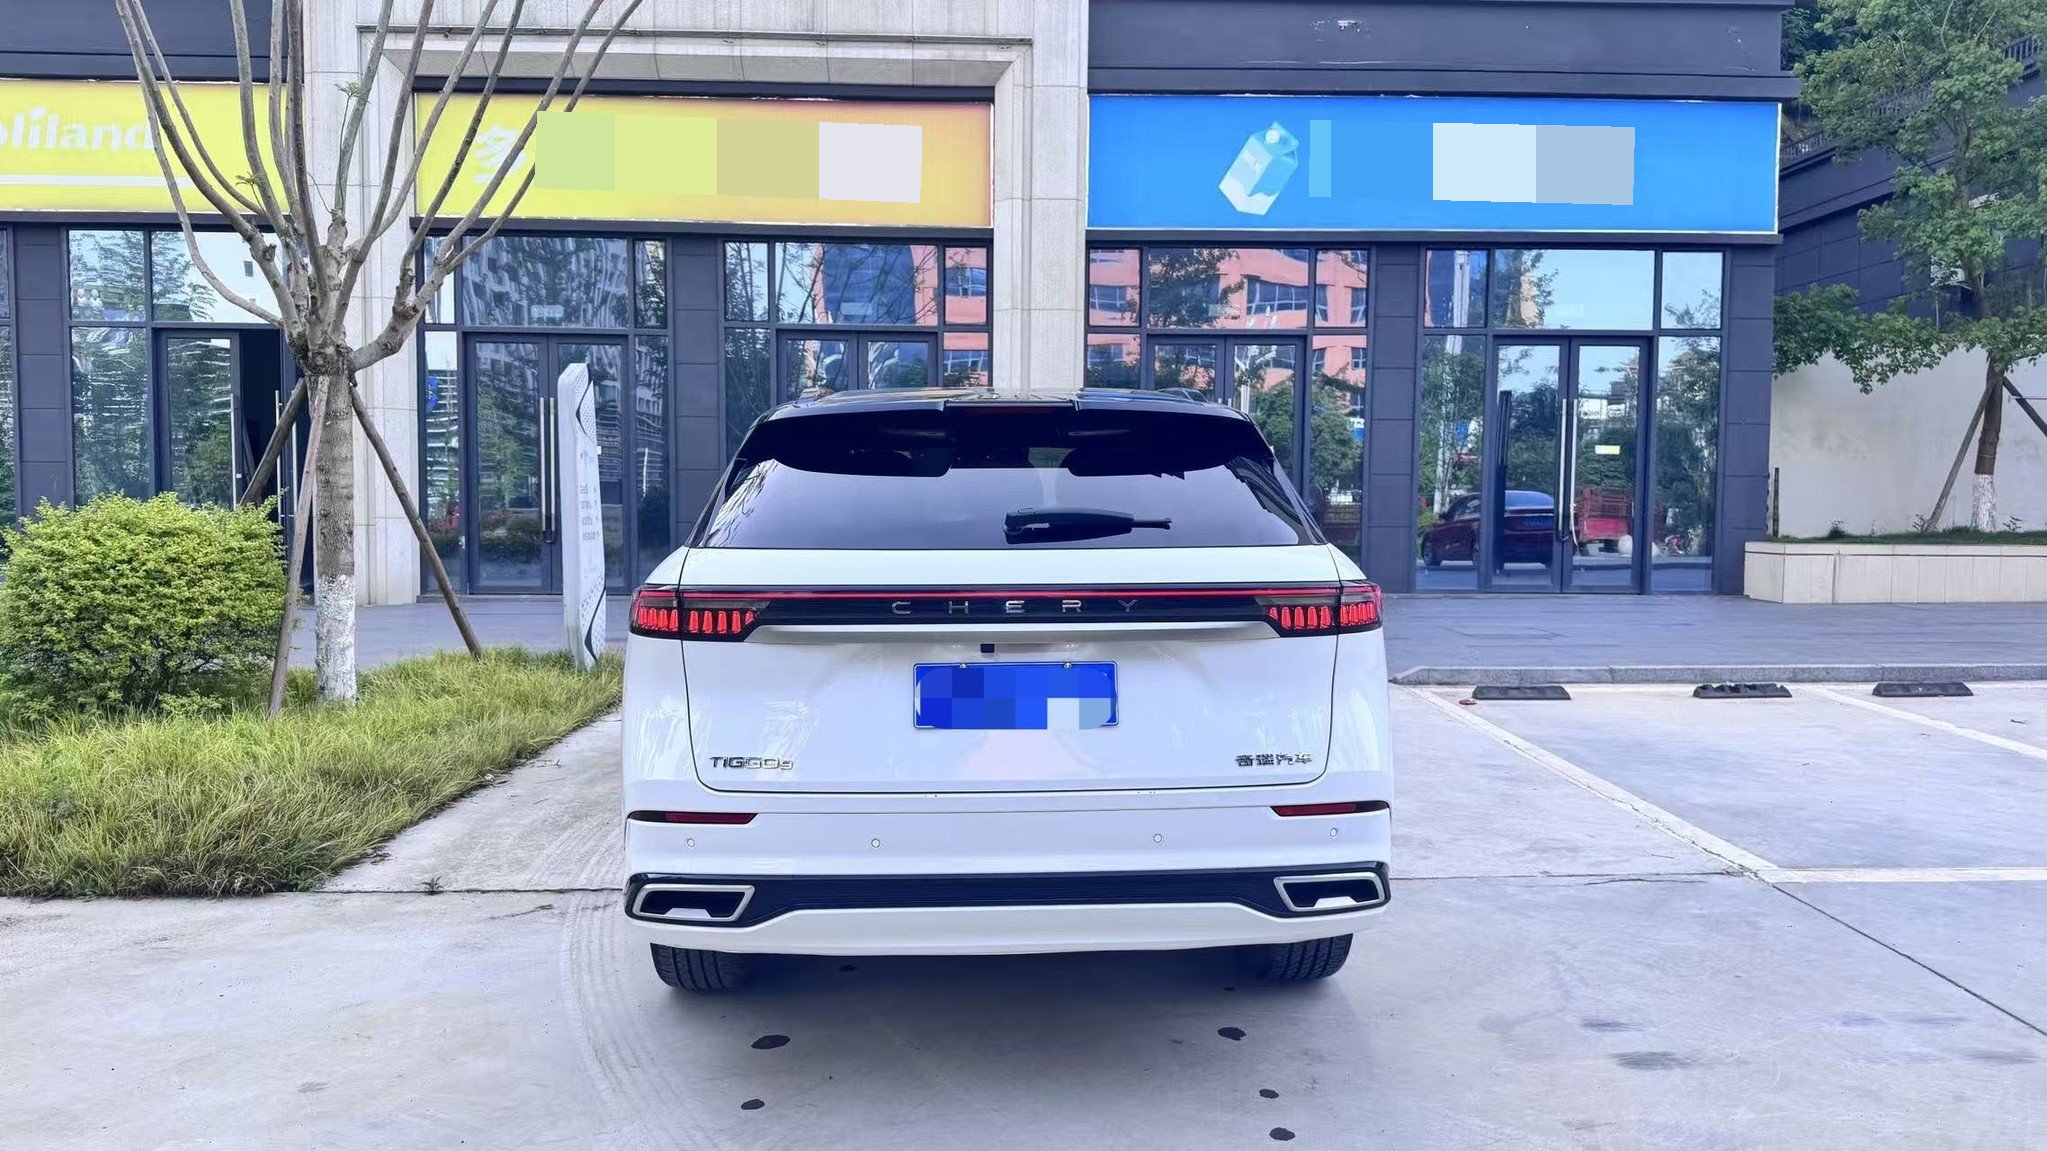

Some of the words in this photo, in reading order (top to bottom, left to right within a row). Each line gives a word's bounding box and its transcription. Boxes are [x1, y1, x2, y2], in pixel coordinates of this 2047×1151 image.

[892, 599, 1137, 614] CHERY
[1235, 752, 1313, 767] 奇瑞汽车
